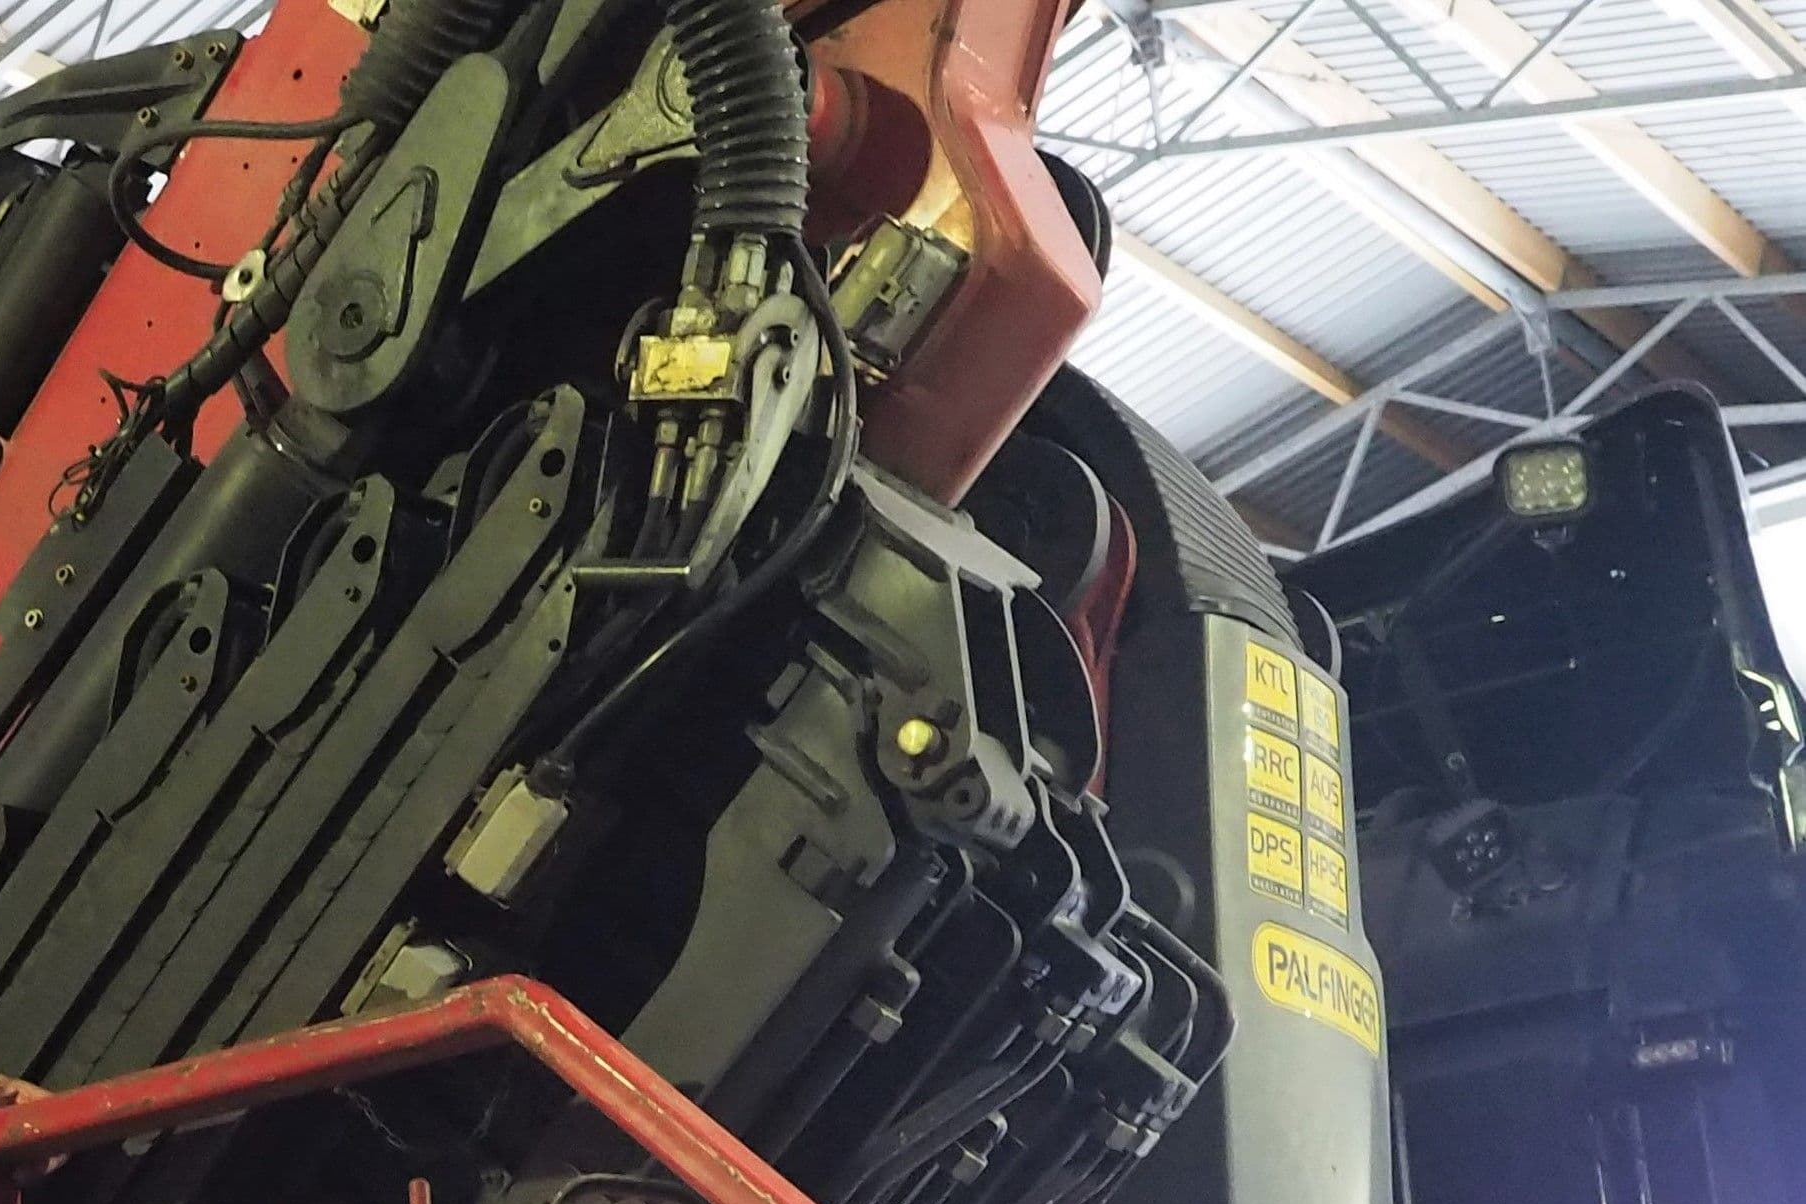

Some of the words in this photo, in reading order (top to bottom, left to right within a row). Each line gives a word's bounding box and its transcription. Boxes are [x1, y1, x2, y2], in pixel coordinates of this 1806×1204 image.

[1255, 655, 1290, 697] KTL
[1254, 744, 1294, 784] RRC
[1310, 772, 1339, 808] AOS
[1251, 826, 1292, 866] DPS
[1310, 847, 1345, 895] HPSC
[1268, 941, 1378, 1042] PALFINGER
